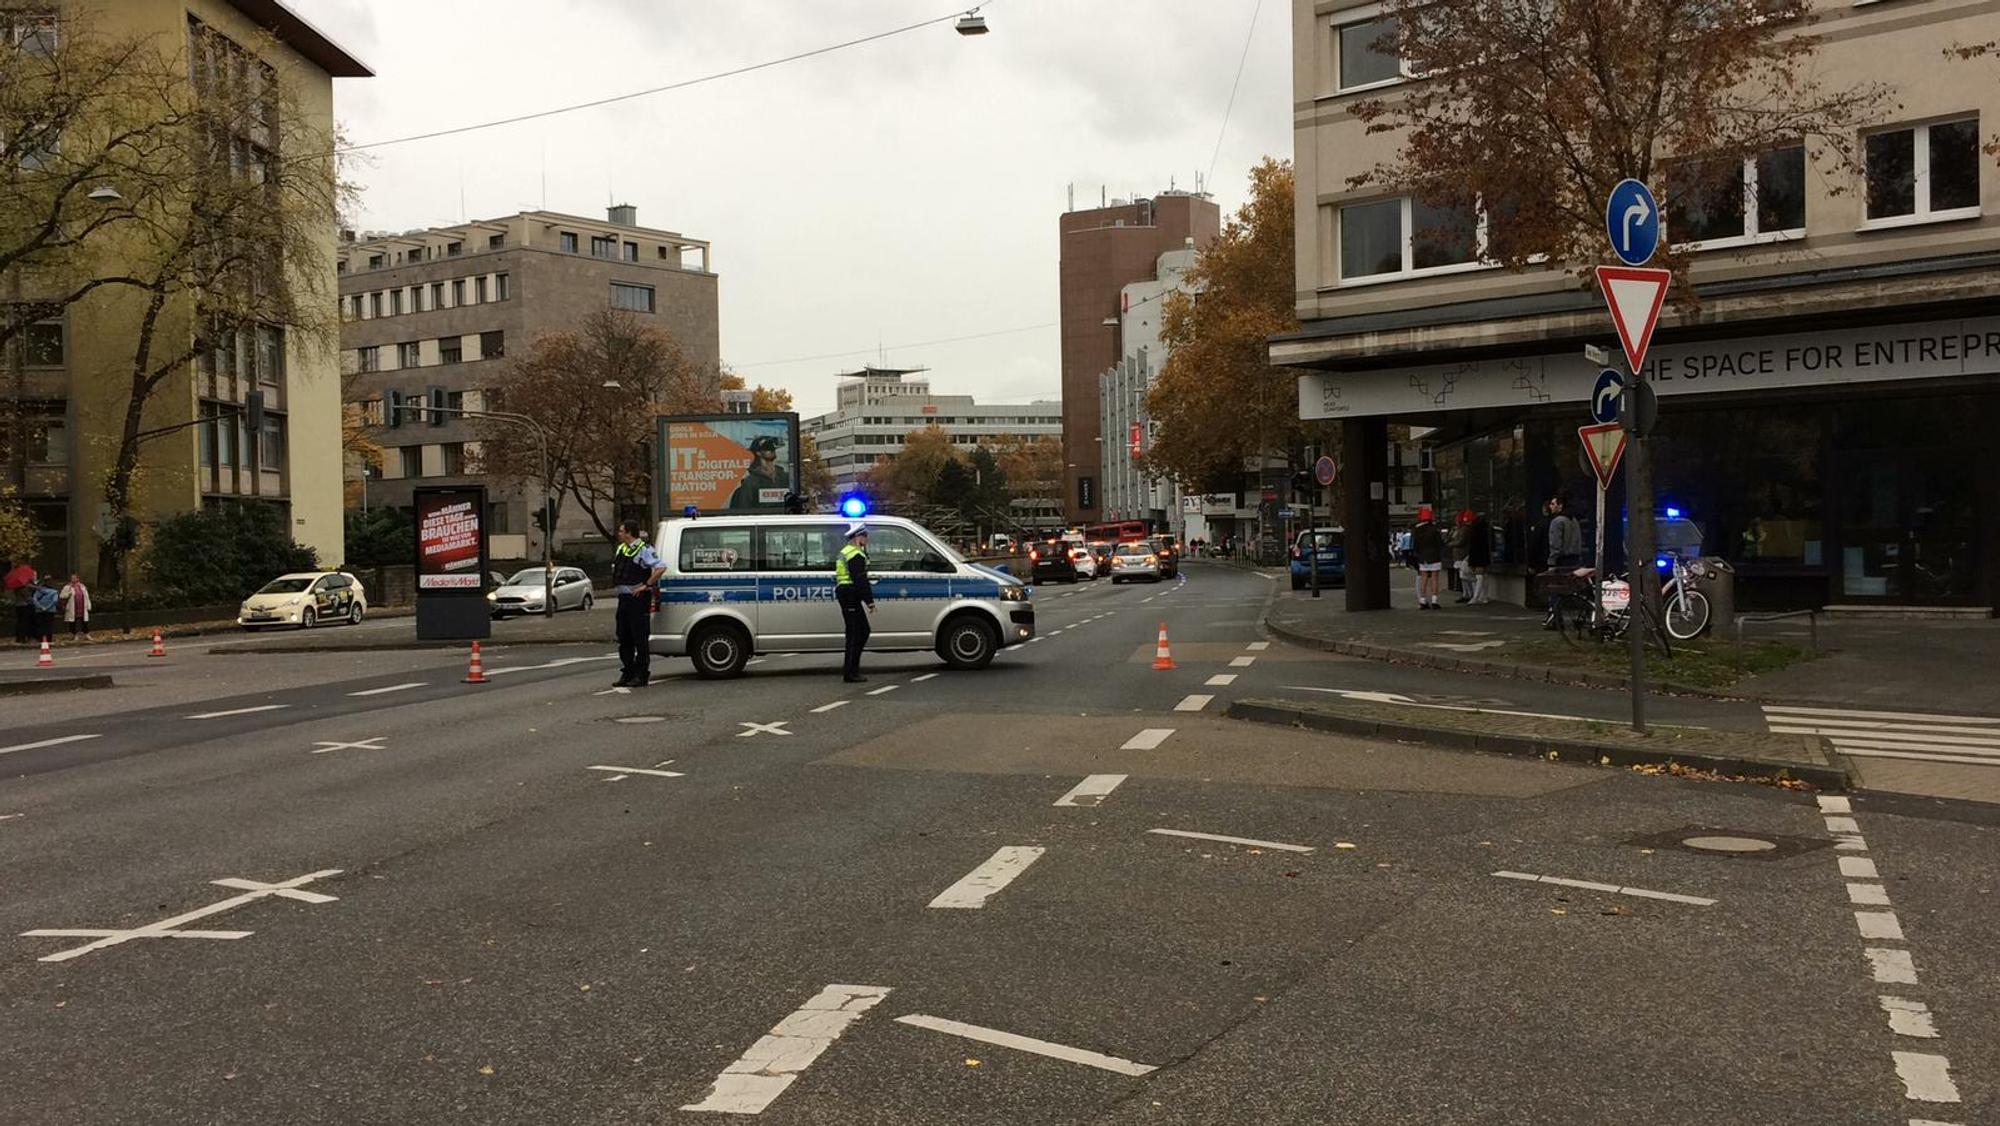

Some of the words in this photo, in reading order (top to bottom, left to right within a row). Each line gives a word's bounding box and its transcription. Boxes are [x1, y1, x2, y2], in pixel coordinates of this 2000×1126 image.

[1644, 357, 1673, 381] HE
[1683, 351, 1774, 379] SPACE
[1786, 344, 1843, 372] FOR
[1855, 331, 2000, 366] ENTREPR
[670, 447, 698, 470] IT
[698, 459, 751, 469] DIGITALE
[671, 470, 738, 480] TRANSFOR-
[671, 481, 717, 492] MATION
[421, 518, 479, 541] BRAUCHEN
[773, 586, 837, 600] POLIZEI
